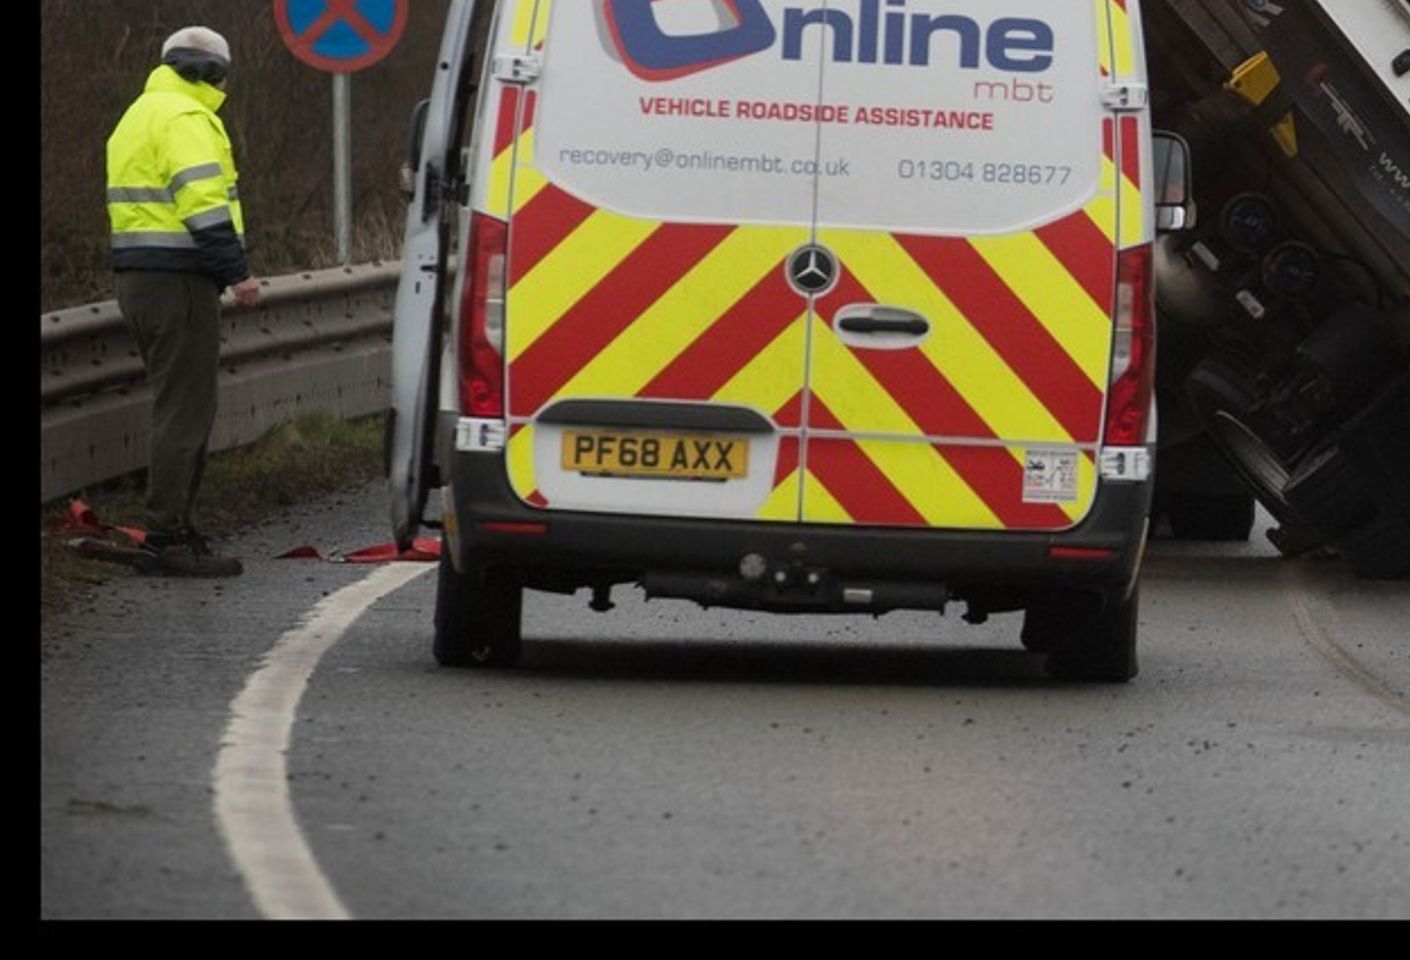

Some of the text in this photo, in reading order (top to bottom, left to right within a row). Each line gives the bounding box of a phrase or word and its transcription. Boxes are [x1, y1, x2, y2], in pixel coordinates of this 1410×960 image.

[973, 77, 1055, 104] mbt
[639, 96, 994, 130] VEHICLE ROADSIDE ASSISTANCE
[559, 147, 850, 176] recovery@onlinembt.co.uk
[898, 159, 1072, 185] 01304 828677
[573, 435, 735, 473] PF68 AXX
